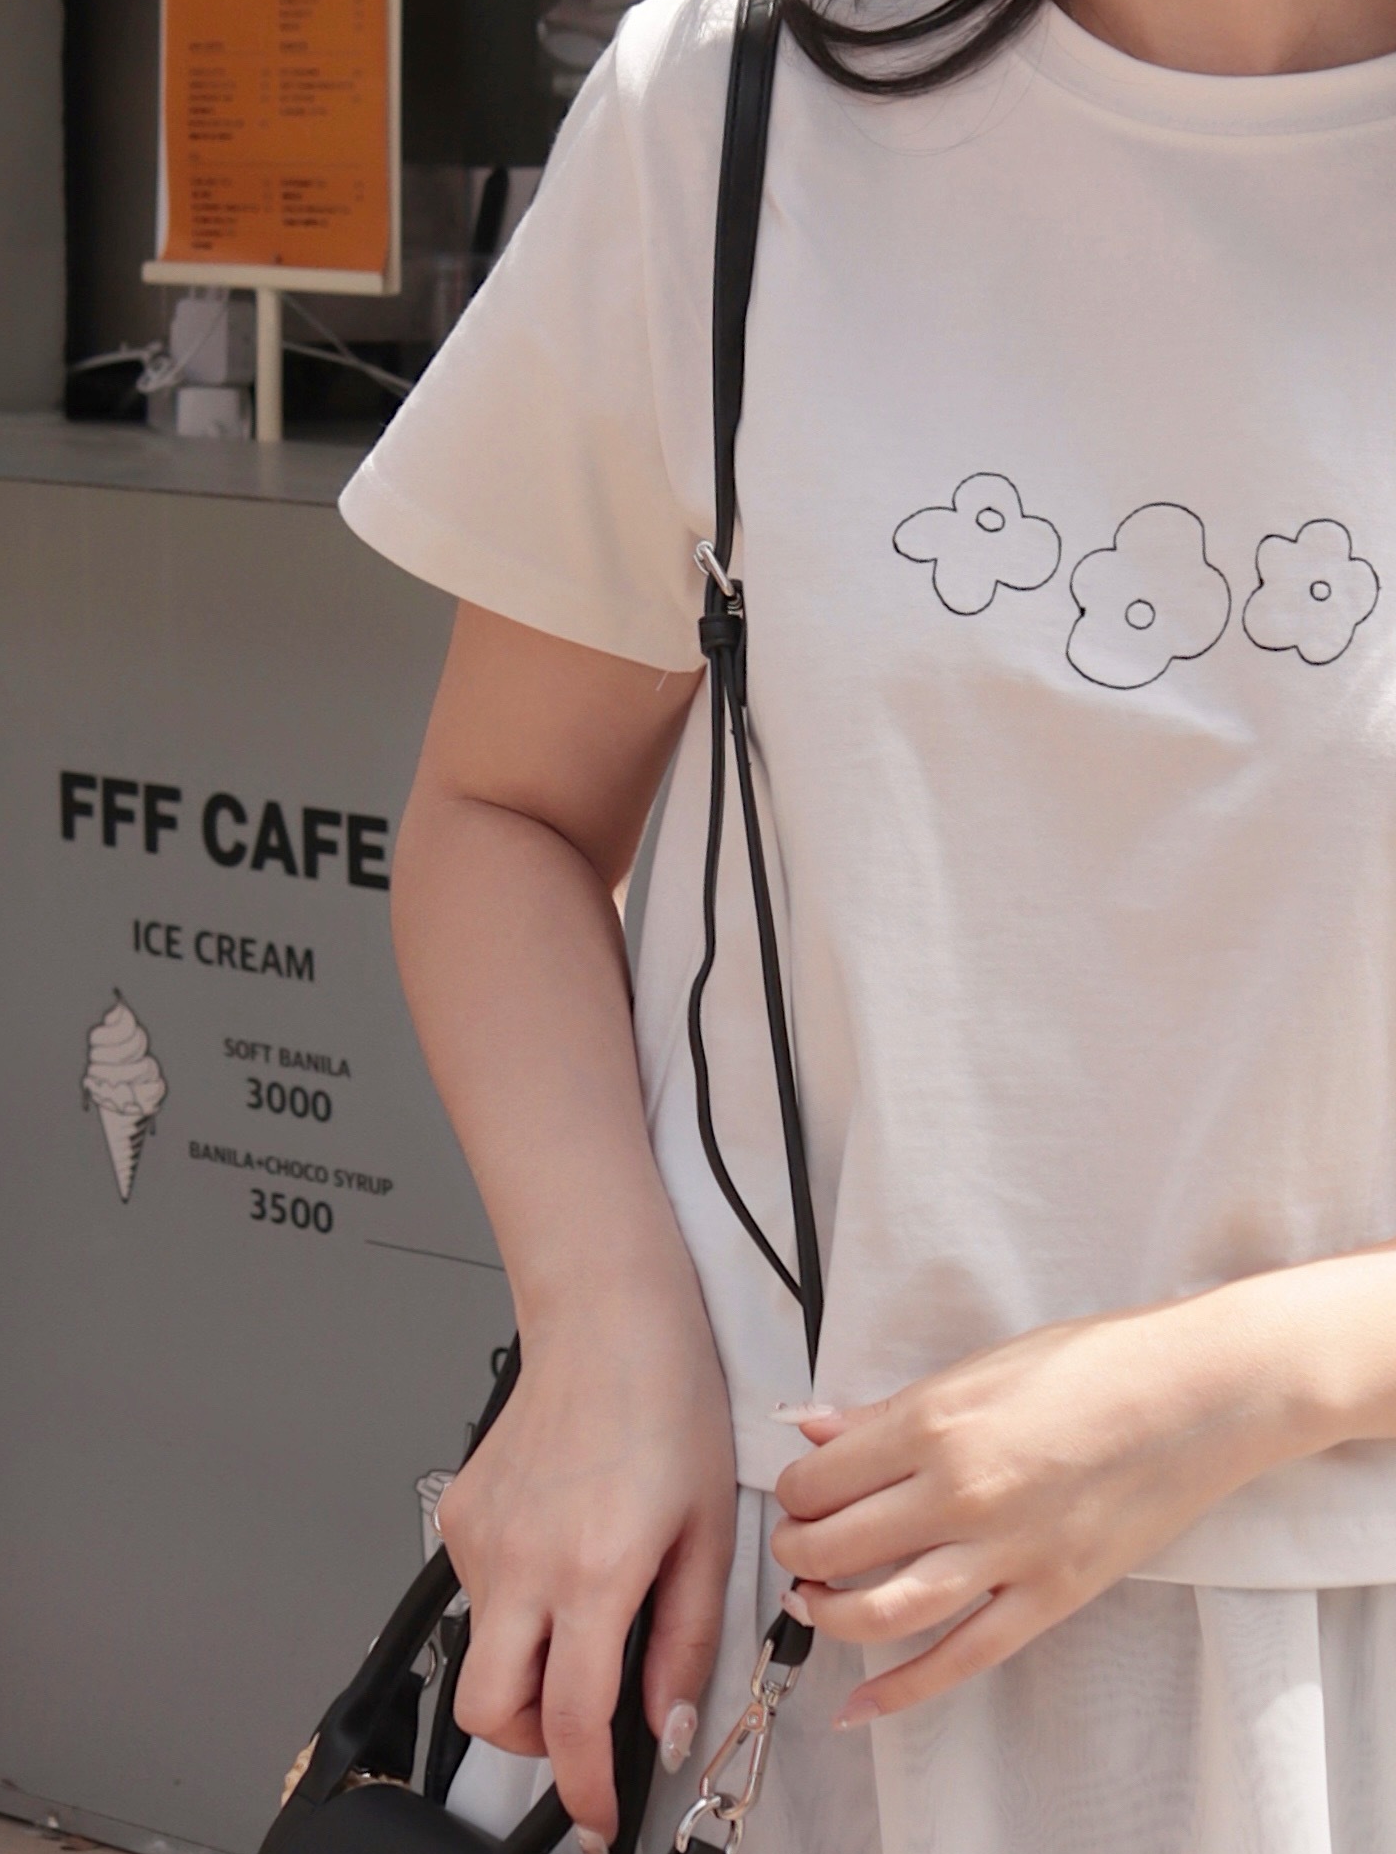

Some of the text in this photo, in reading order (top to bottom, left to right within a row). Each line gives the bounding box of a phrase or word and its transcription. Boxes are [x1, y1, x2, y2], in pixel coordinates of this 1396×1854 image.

[60, 770, 390, 891] FFF CAFE
[133, 918, 315, 982] ICE CREAM
[223, 1037, 351, 1079] SOFT BANILA
[246, 1078, 332, 1123] 3000
[189, 1141, 394, 1197] BANILA+CHOCO SYRUP
[249, 1189, 334, 1234] 3500
